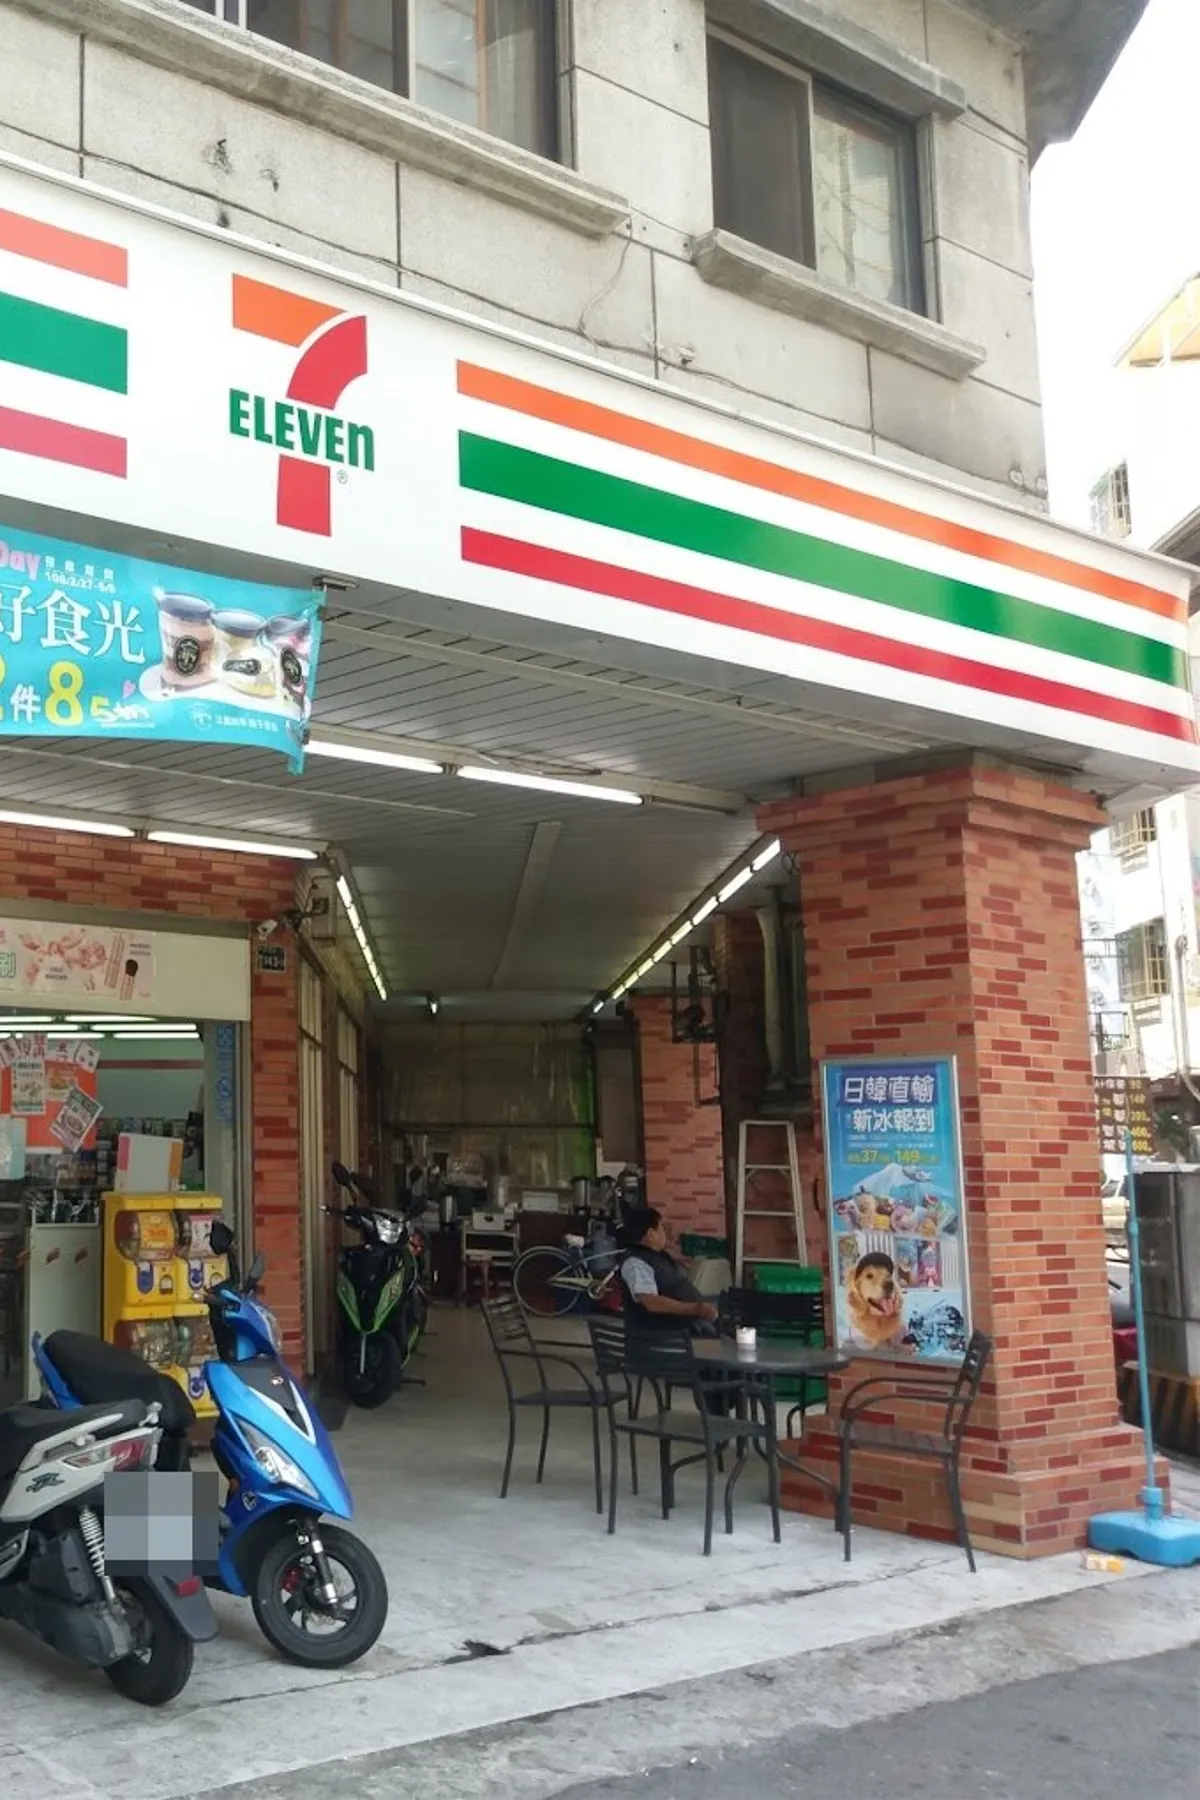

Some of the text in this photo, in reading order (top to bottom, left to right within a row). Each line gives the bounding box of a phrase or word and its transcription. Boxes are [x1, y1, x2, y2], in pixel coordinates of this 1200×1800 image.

[232, 273, 368, 537] 7
[844, 1074, 936, 1104] 日韓直輸
[853, 1107, 936, 1133] 新冰報到
